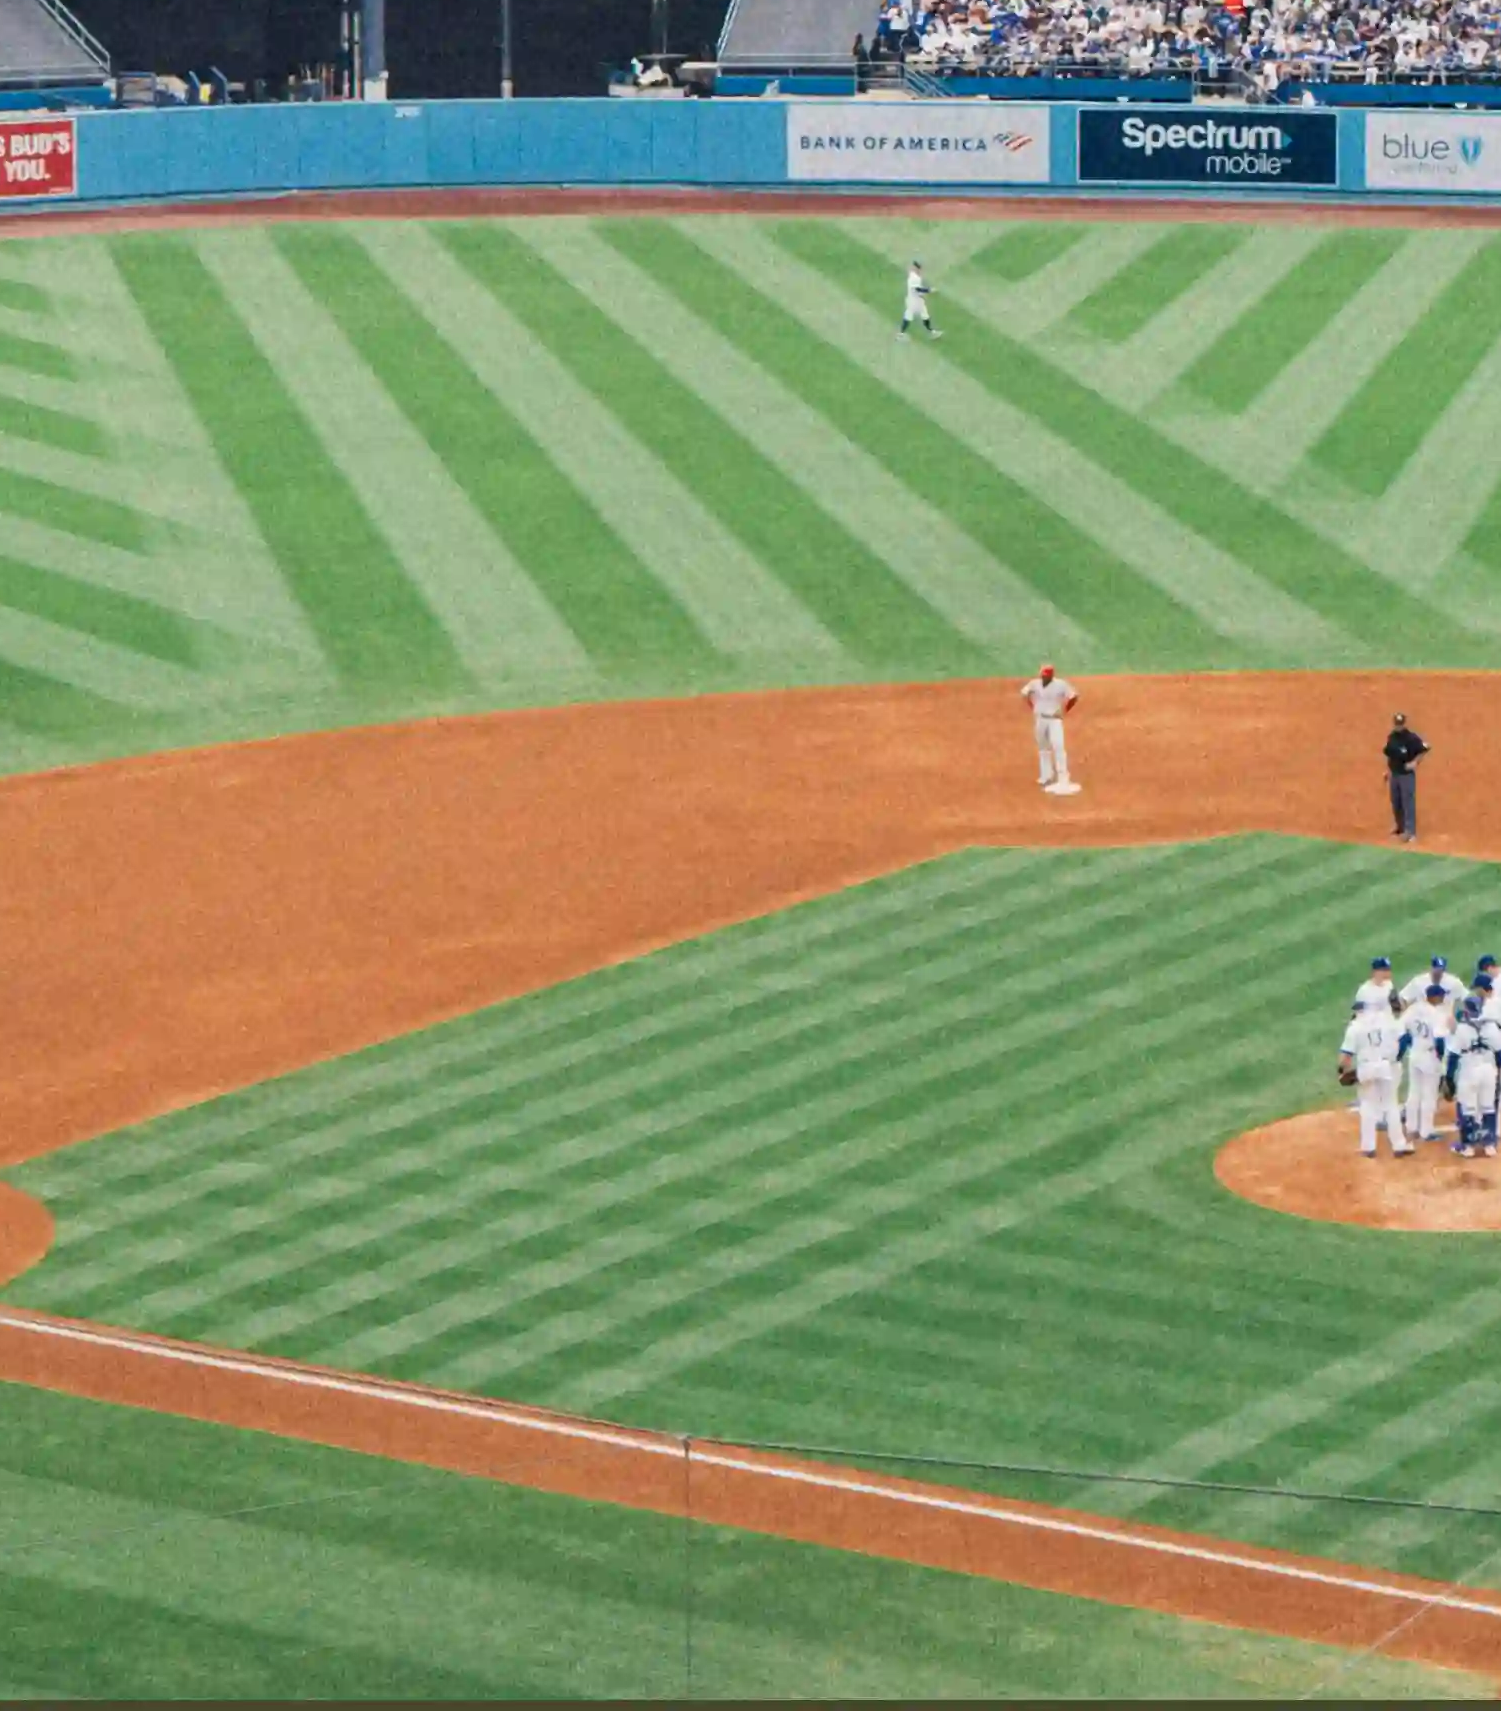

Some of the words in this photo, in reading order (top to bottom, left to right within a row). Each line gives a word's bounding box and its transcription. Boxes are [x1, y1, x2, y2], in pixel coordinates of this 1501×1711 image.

[10, 132, 71, 157] BUD'S
[800, 136, 855, 150] BANK
[863, 136, 888, 150] OF
[893, 137, 987, 151] AMERICA
[1122, 117, 1282, 156] Spectrum
[1383, 133, 1450, 159] blue
[4, 159, 50, 182] YOU.
[1206, 153, 1281, 175] mobile
